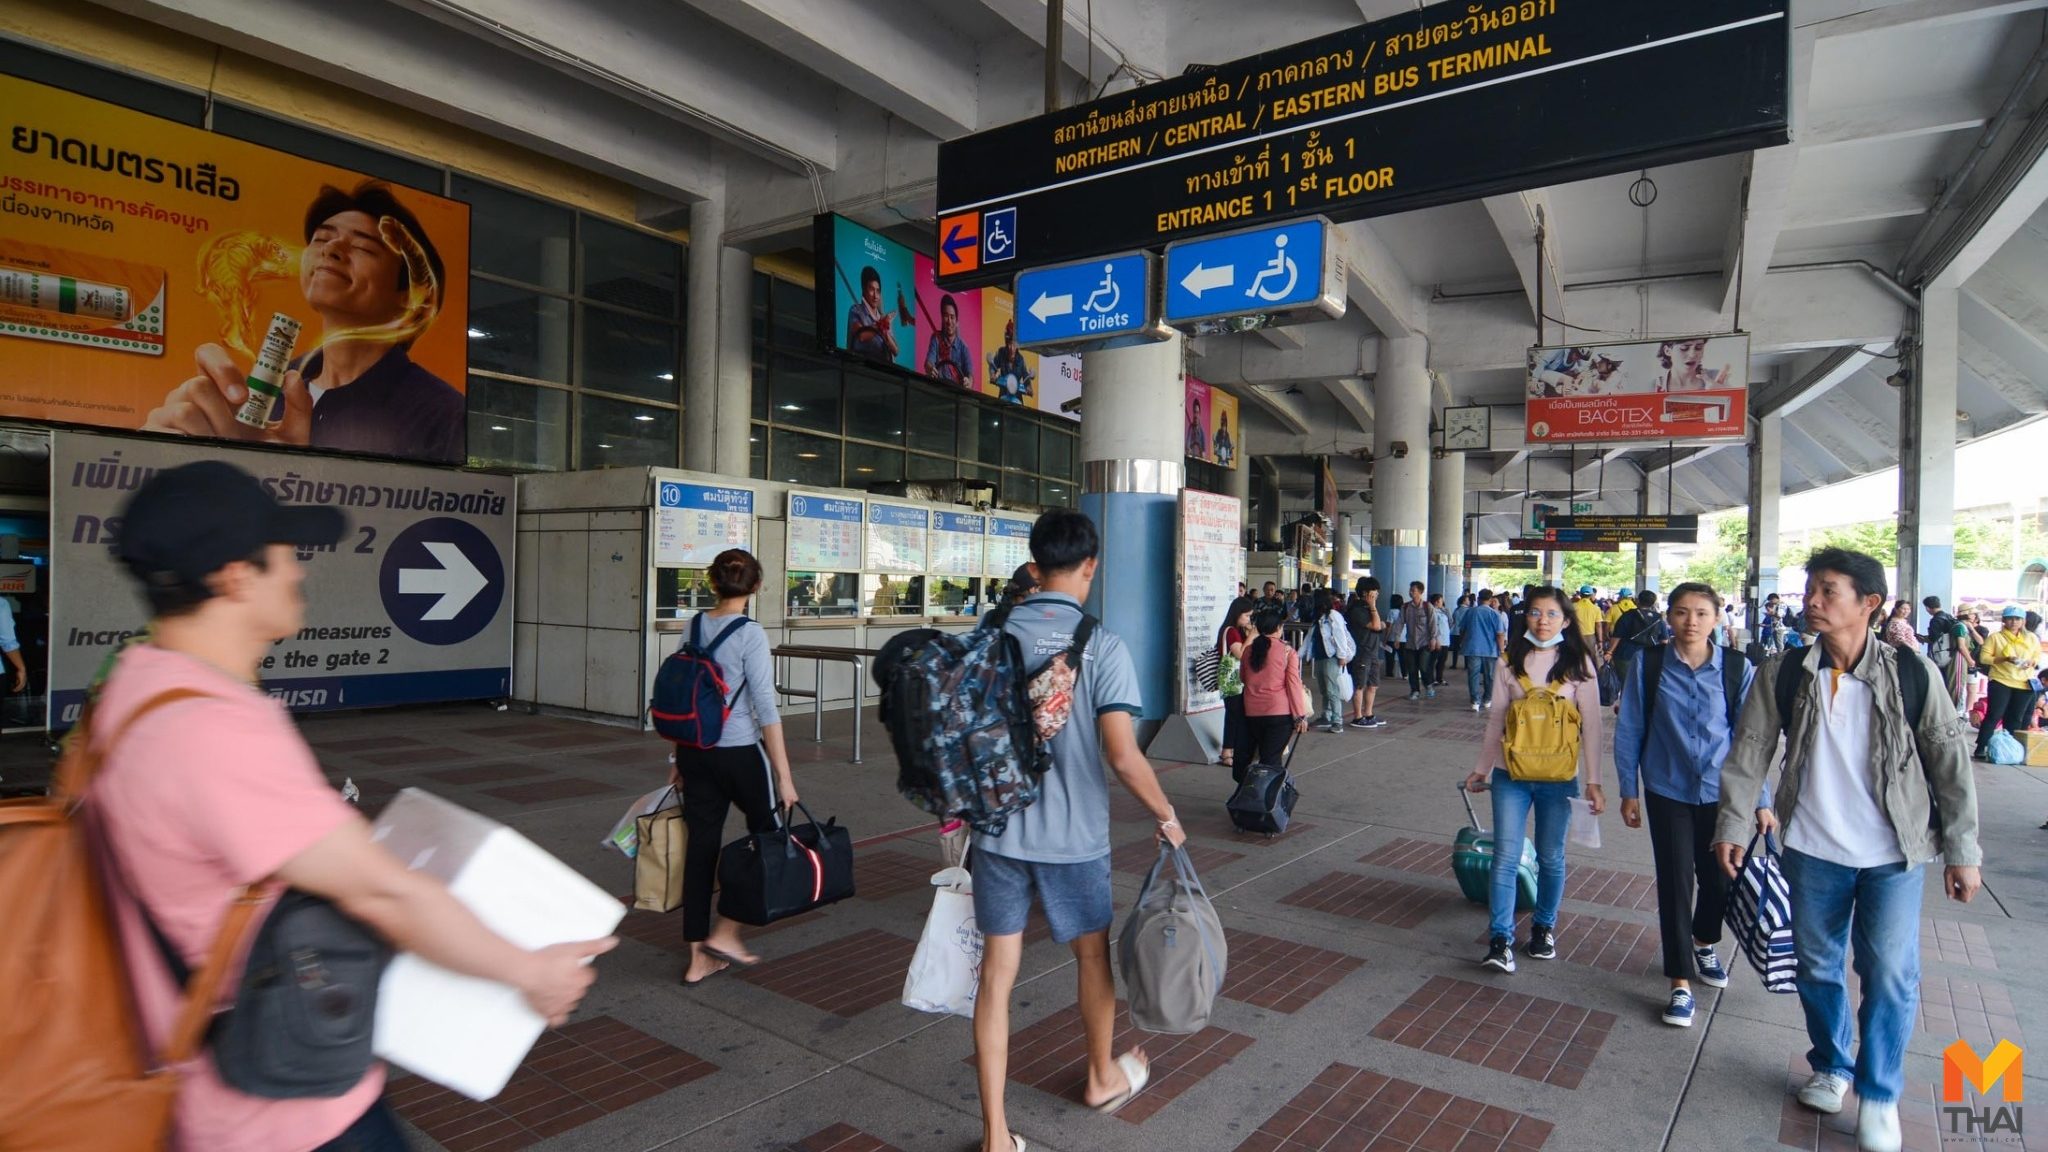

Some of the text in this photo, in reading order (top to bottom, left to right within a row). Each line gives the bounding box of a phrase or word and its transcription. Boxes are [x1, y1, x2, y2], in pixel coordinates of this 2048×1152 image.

[1054, 76, 1230, 144] สถานีขนส่งสายเหนือ
[1257, 47, 1354, 91] ภาคกลาง
[1386, 0, 1556, 58] สายตะวันออก
[1055, 139, 1141, 174] NORTHERN
[1165, 110, 1246, 147] CENTRAL
[1273, 79, 1365, 120] EASTERN
[1374, 66, 1418, 96] BUS
[1428, 34, 1551, 81] TERMINAL
[12, 125, 240, 202] ยาดมตราเสือ
[1186, 132, 1355, 195] ทางเข้าที่ 1 ชั้น 1
[1158, 167, 1394, 233] ENTRANCE 1 1st FLOOR
[1079, 310, 1129, 331] Toilets
[1578, 407, 1653, 424] BACTEX
[662, 487, 679, 503] 10
[794, 500, 805, 513] 11
[934, 515, 943, 527] 13
[354, 526, 376, 553] 2
[296, 624, 391, 642] measures
[284, 651, 319, 669] the
[326, 650, 370, 672] gate
[377, 649, 389, 664] 2
